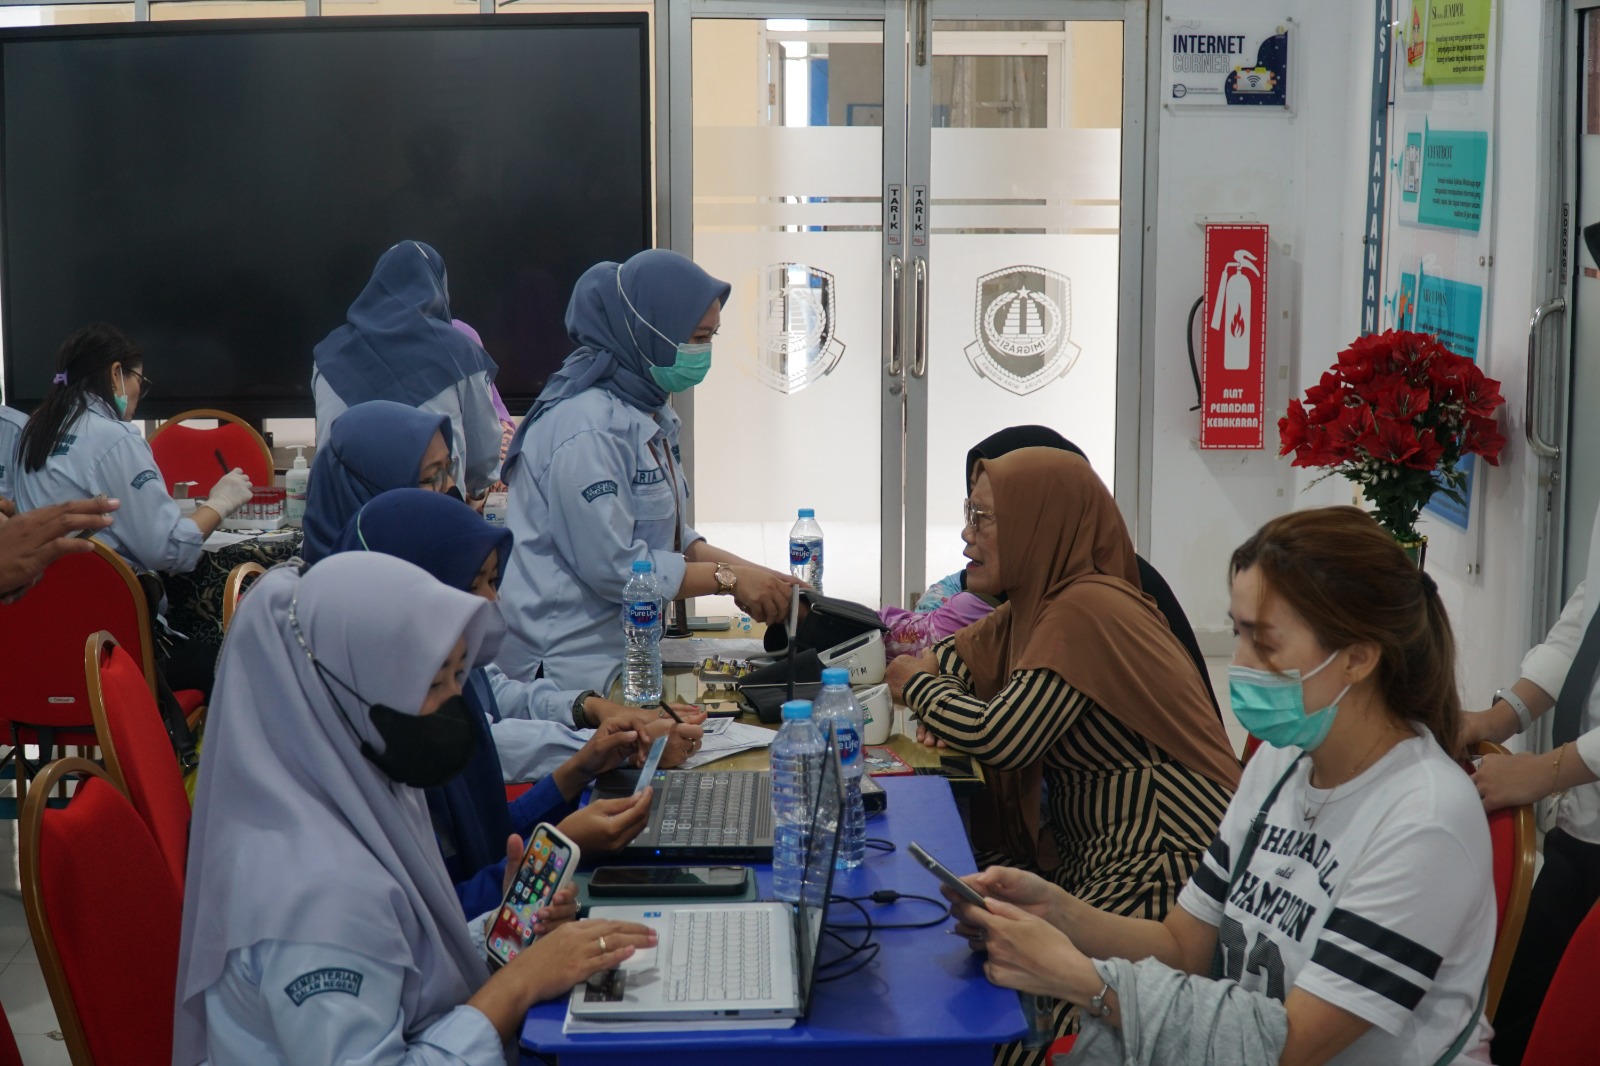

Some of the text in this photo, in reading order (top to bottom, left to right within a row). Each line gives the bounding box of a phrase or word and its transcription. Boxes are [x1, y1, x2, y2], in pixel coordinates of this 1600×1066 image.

[1173, 34, 1246, 54] INTERNET
[1172, 53, 1231, 74] CORNER
[890, 188, 900, 230] TARIK
[914, 189, 924, 231] TARIK
[1366, 120, 1382, 332] LAYANAN
[1223, 388, 1243, 399] ALAT
[1210, 402, 1255, 413] PEMADAM
[1206, 417, 1259, 428] KEBAKARAN
[647, 611, 658, 619] Life
[845, 740, 859, 752] Life
[1229, 868, 1318, 943] HAMPION
